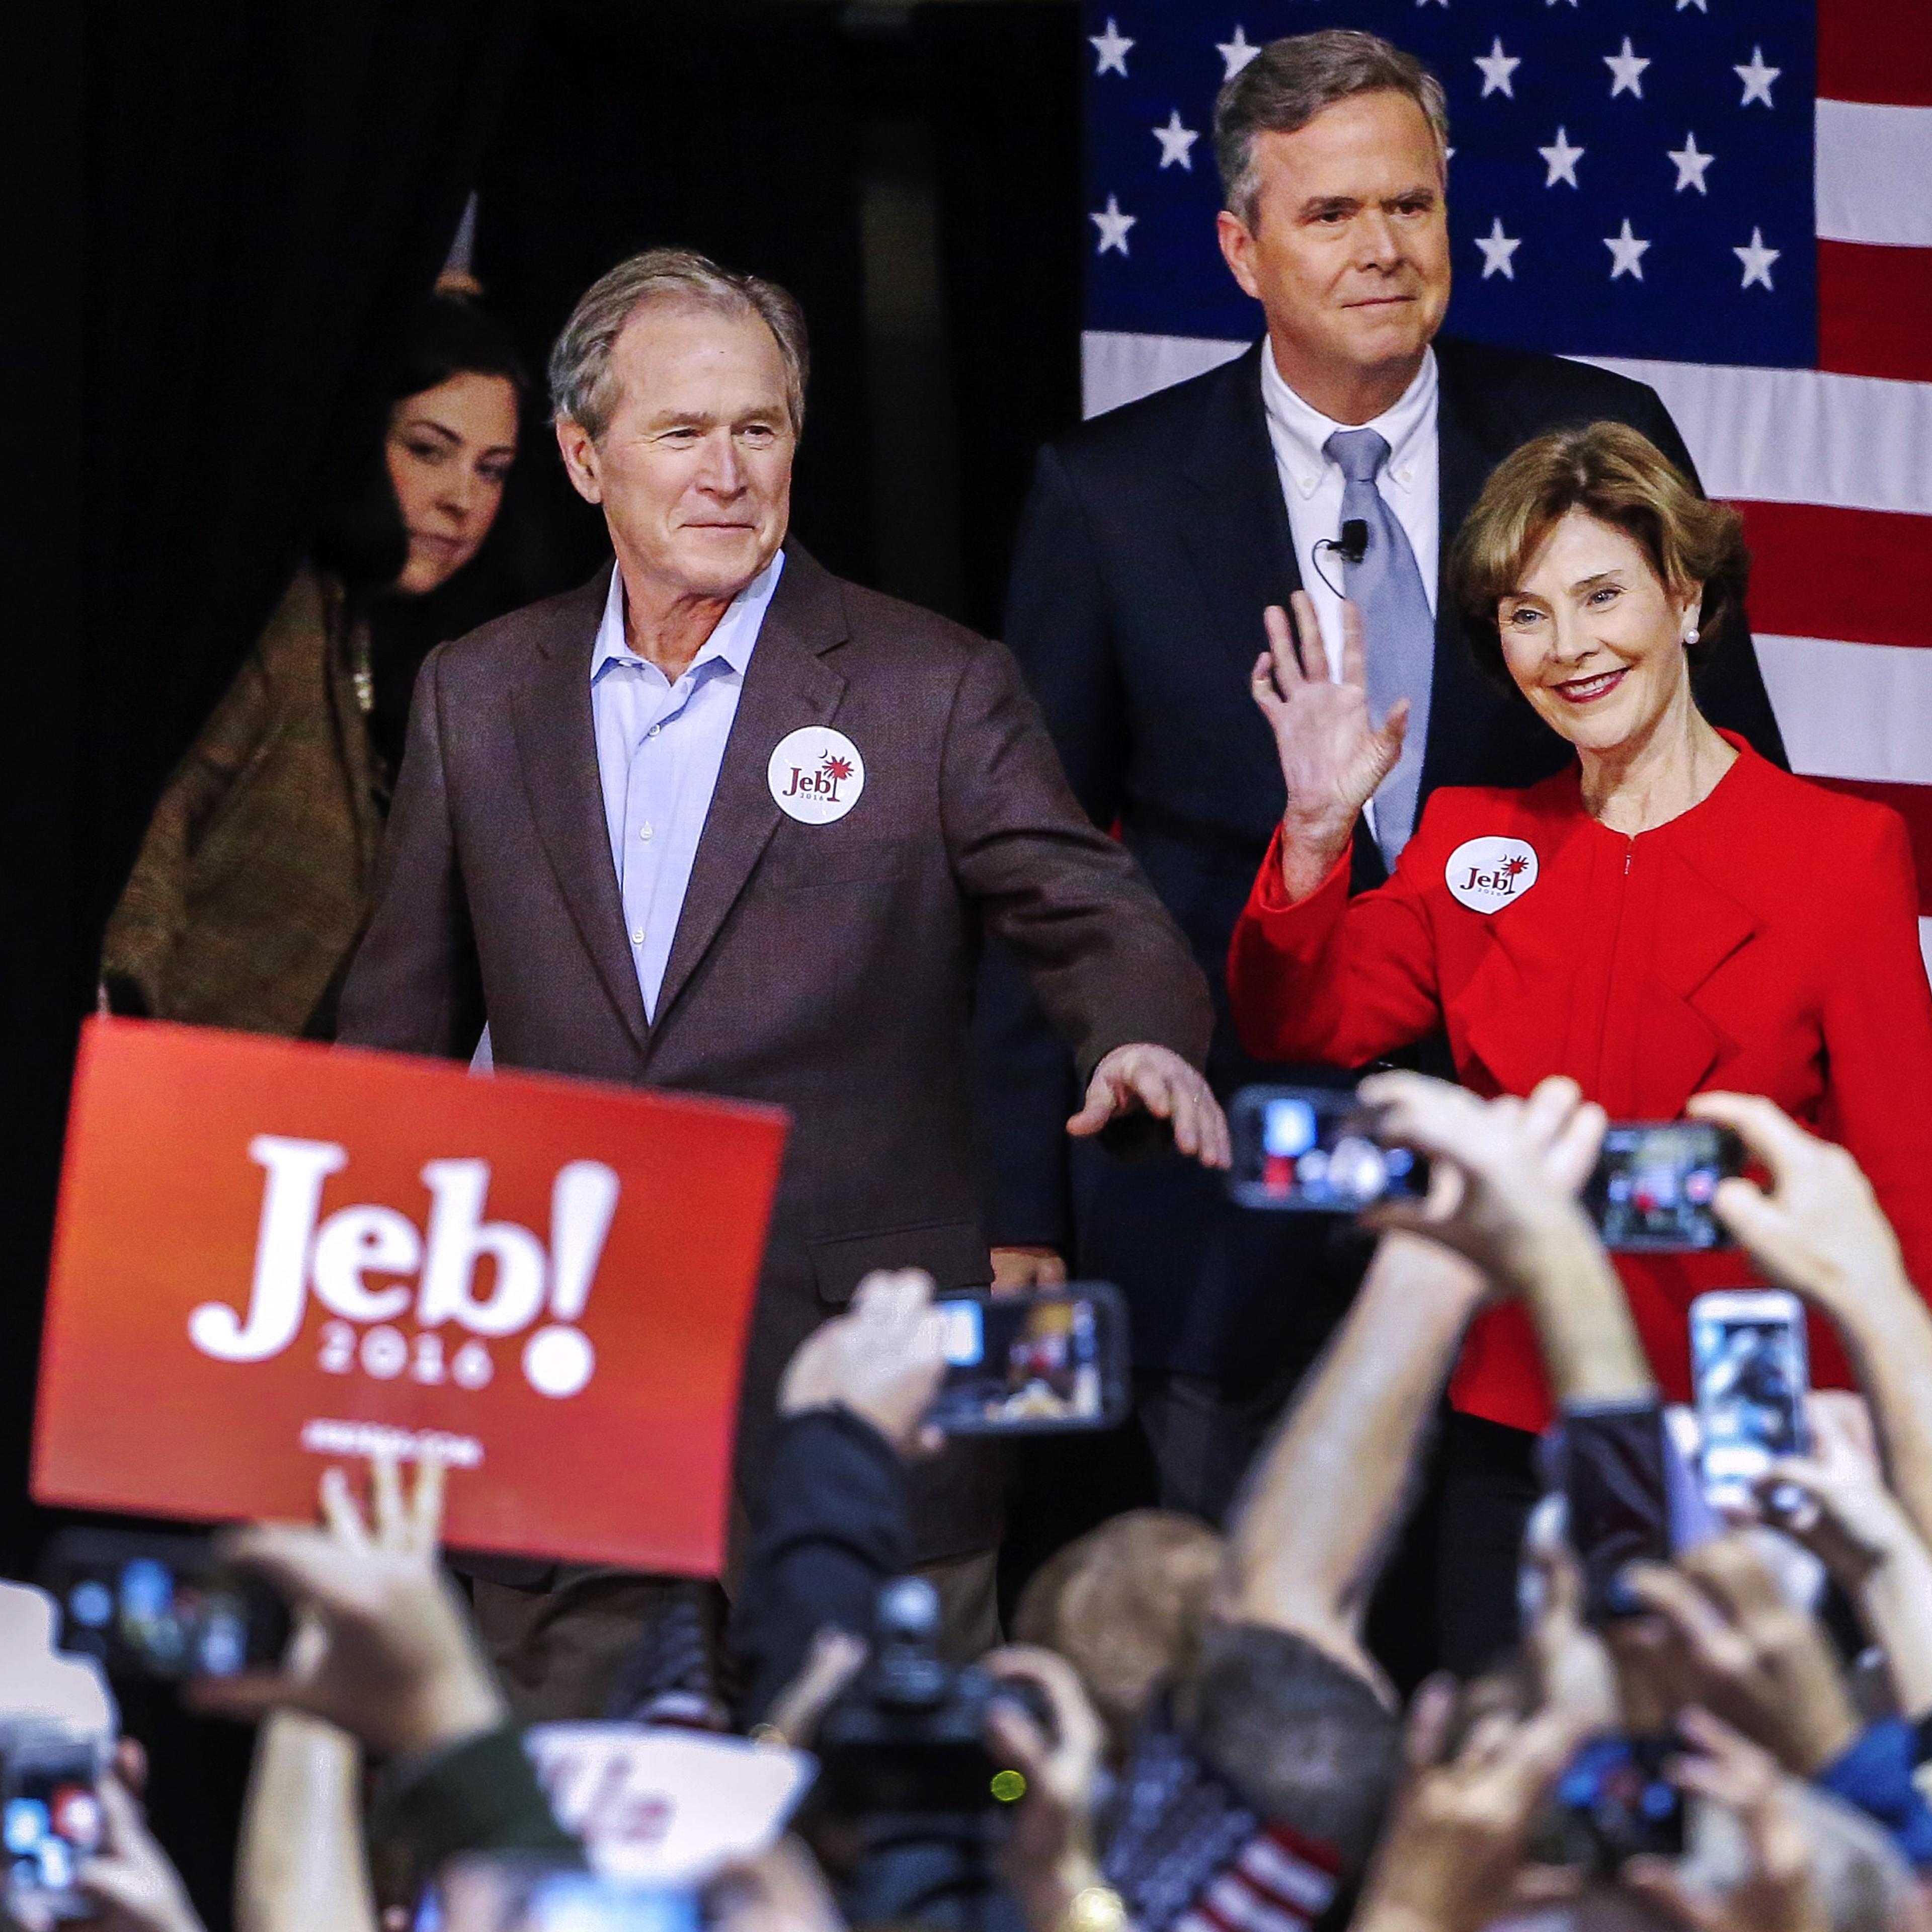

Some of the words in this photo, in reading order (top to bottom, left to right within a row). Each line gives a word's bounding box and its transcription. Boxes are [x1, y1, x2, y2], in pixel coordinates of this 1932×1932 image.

[800, 792, 824, 801] 2016
[187, 1134, 620, 1398] Jeb!
[318, 1323, 493, 1390] 2016
